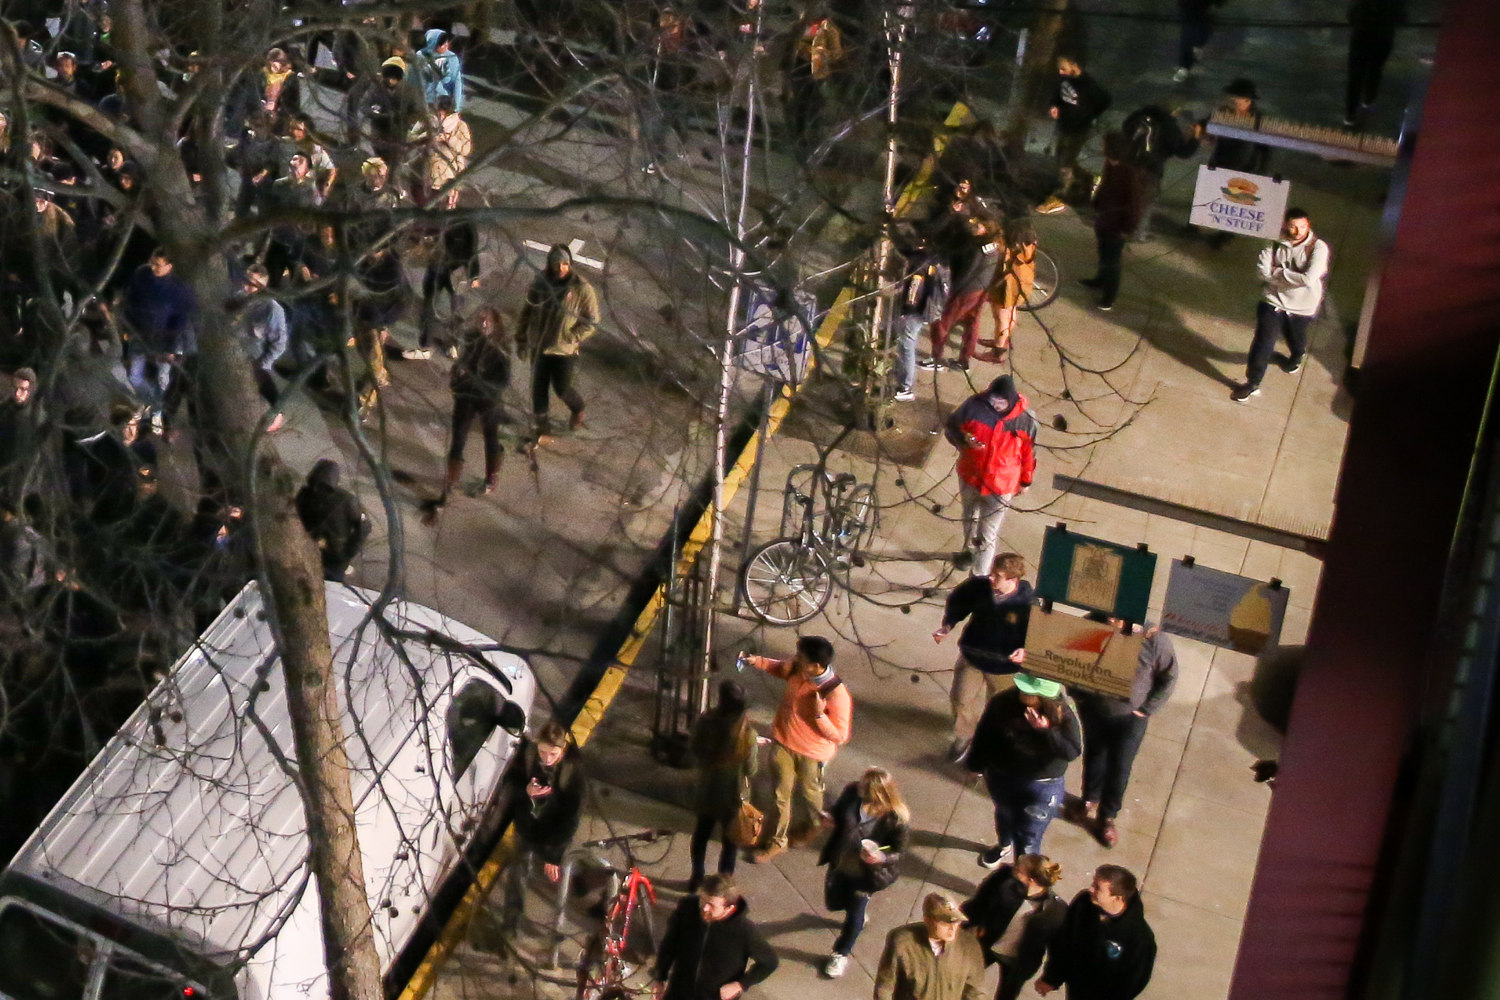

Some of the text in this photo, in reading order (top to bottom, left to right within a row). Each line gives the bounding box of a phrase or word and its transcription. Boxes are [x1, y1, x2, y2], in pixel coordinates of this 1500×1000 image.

[1209, 202, 1265, 222] CHEESE
[1226, 217, 1264, 232] STUFF
[1044, 649, 1113, 678] Revolution
[1056, 663, 1096, 683] Books
